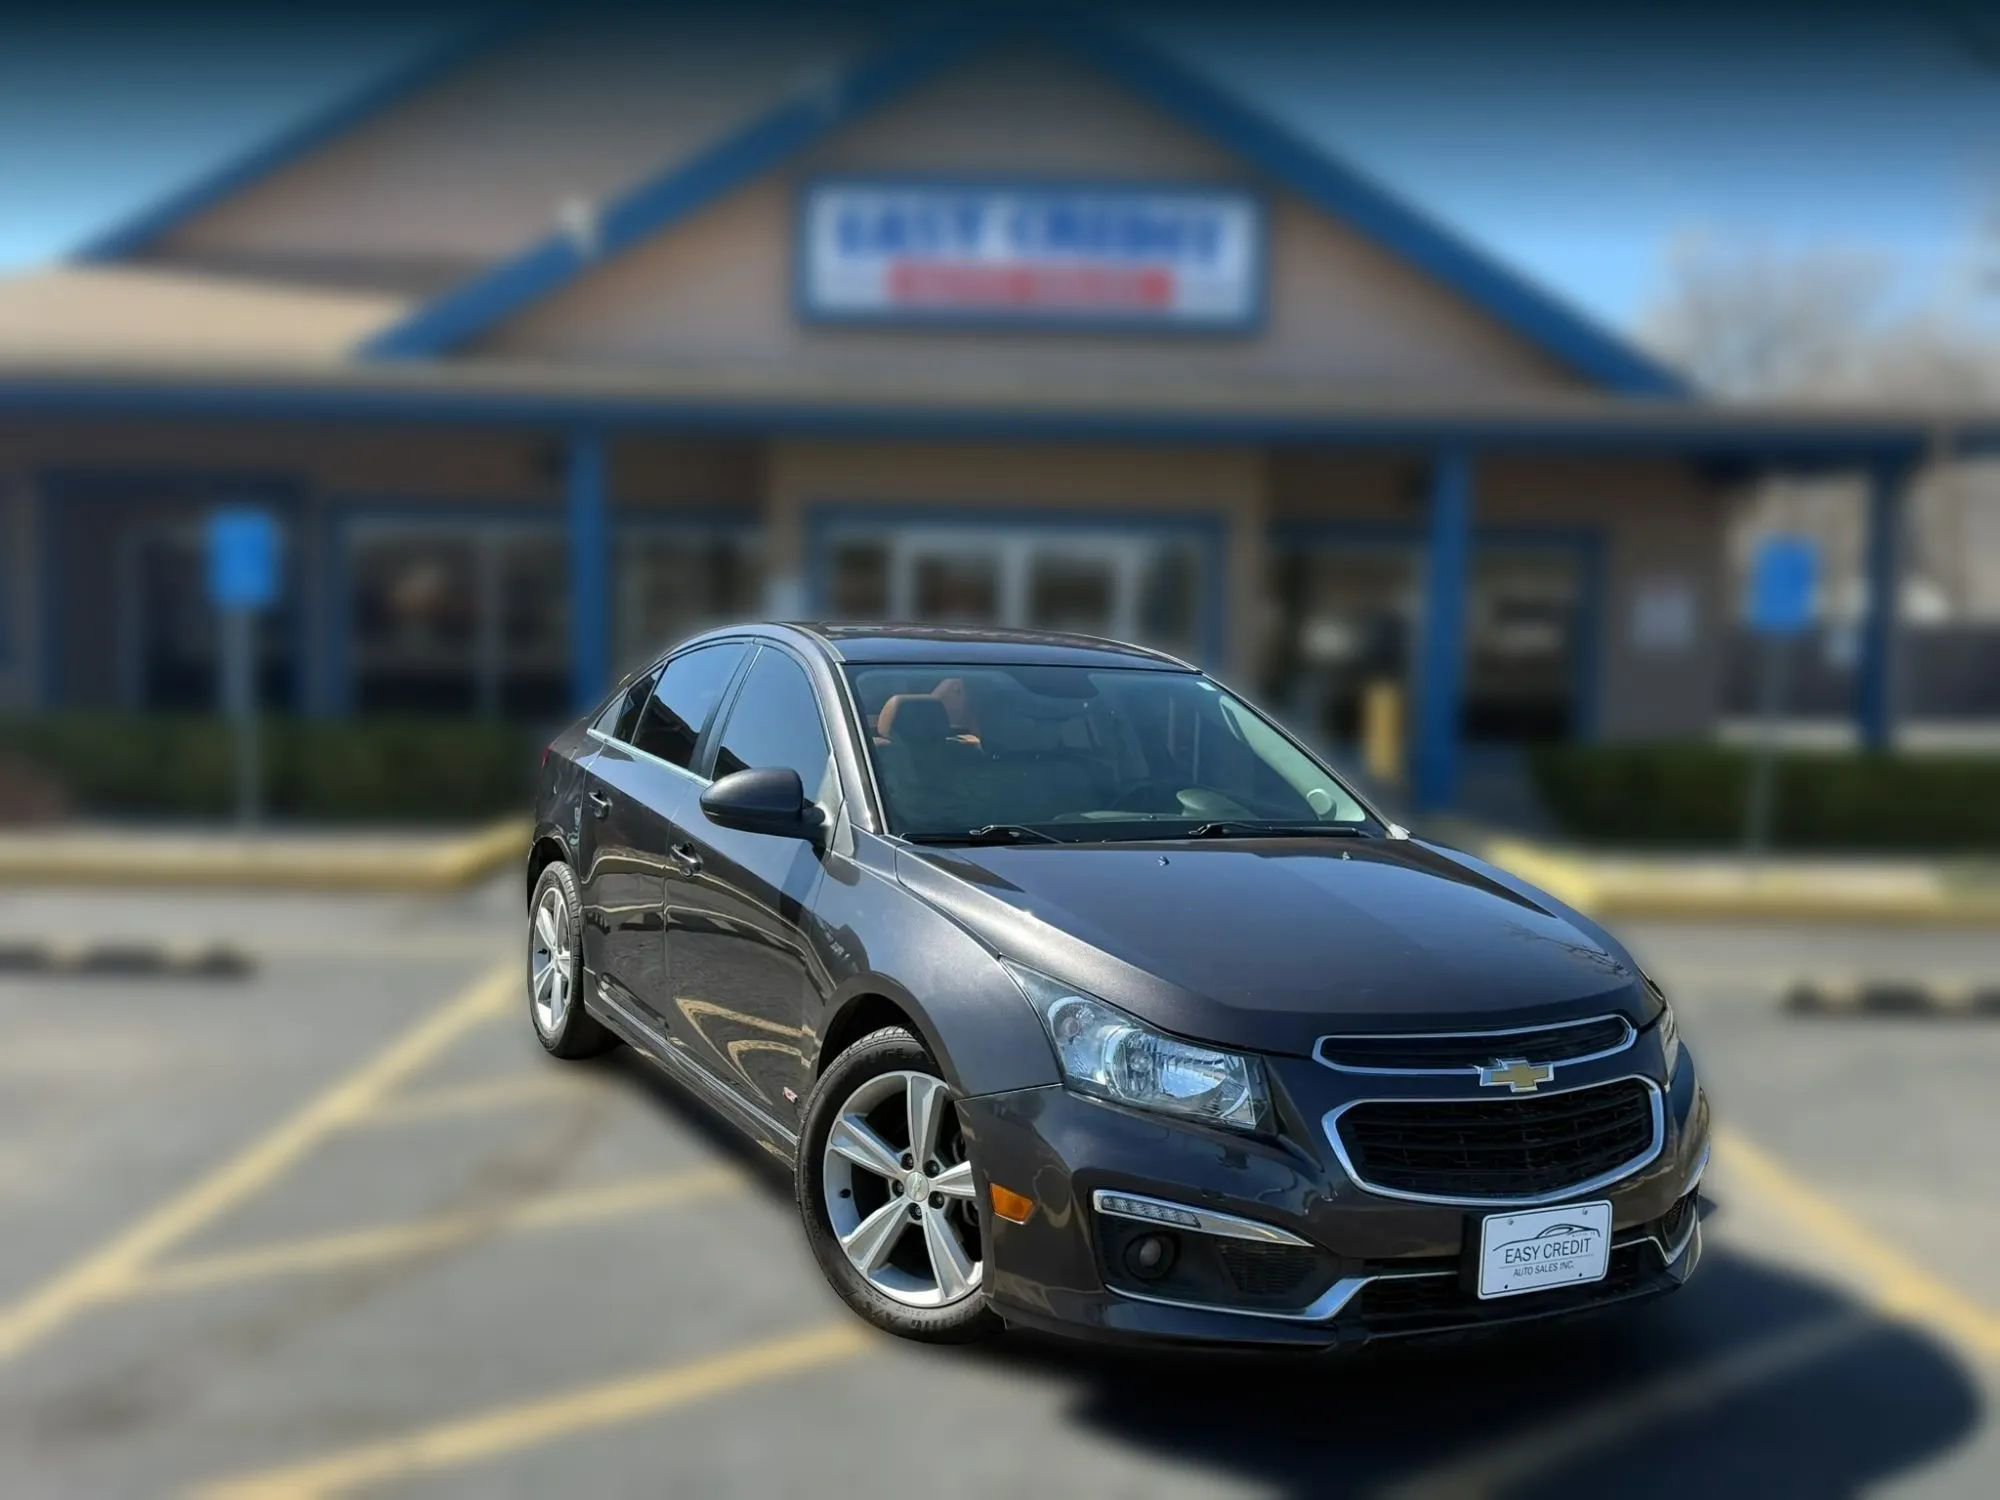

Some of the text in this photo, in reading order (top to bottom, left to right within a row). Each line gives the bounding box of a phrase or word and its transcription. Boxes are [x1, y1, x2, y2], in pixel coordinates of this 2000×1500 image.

[1505, 1238, 1592, 1264] EASY CREDIT
[1513, 1261, 1575, 1276] AUTO SALES INC.
